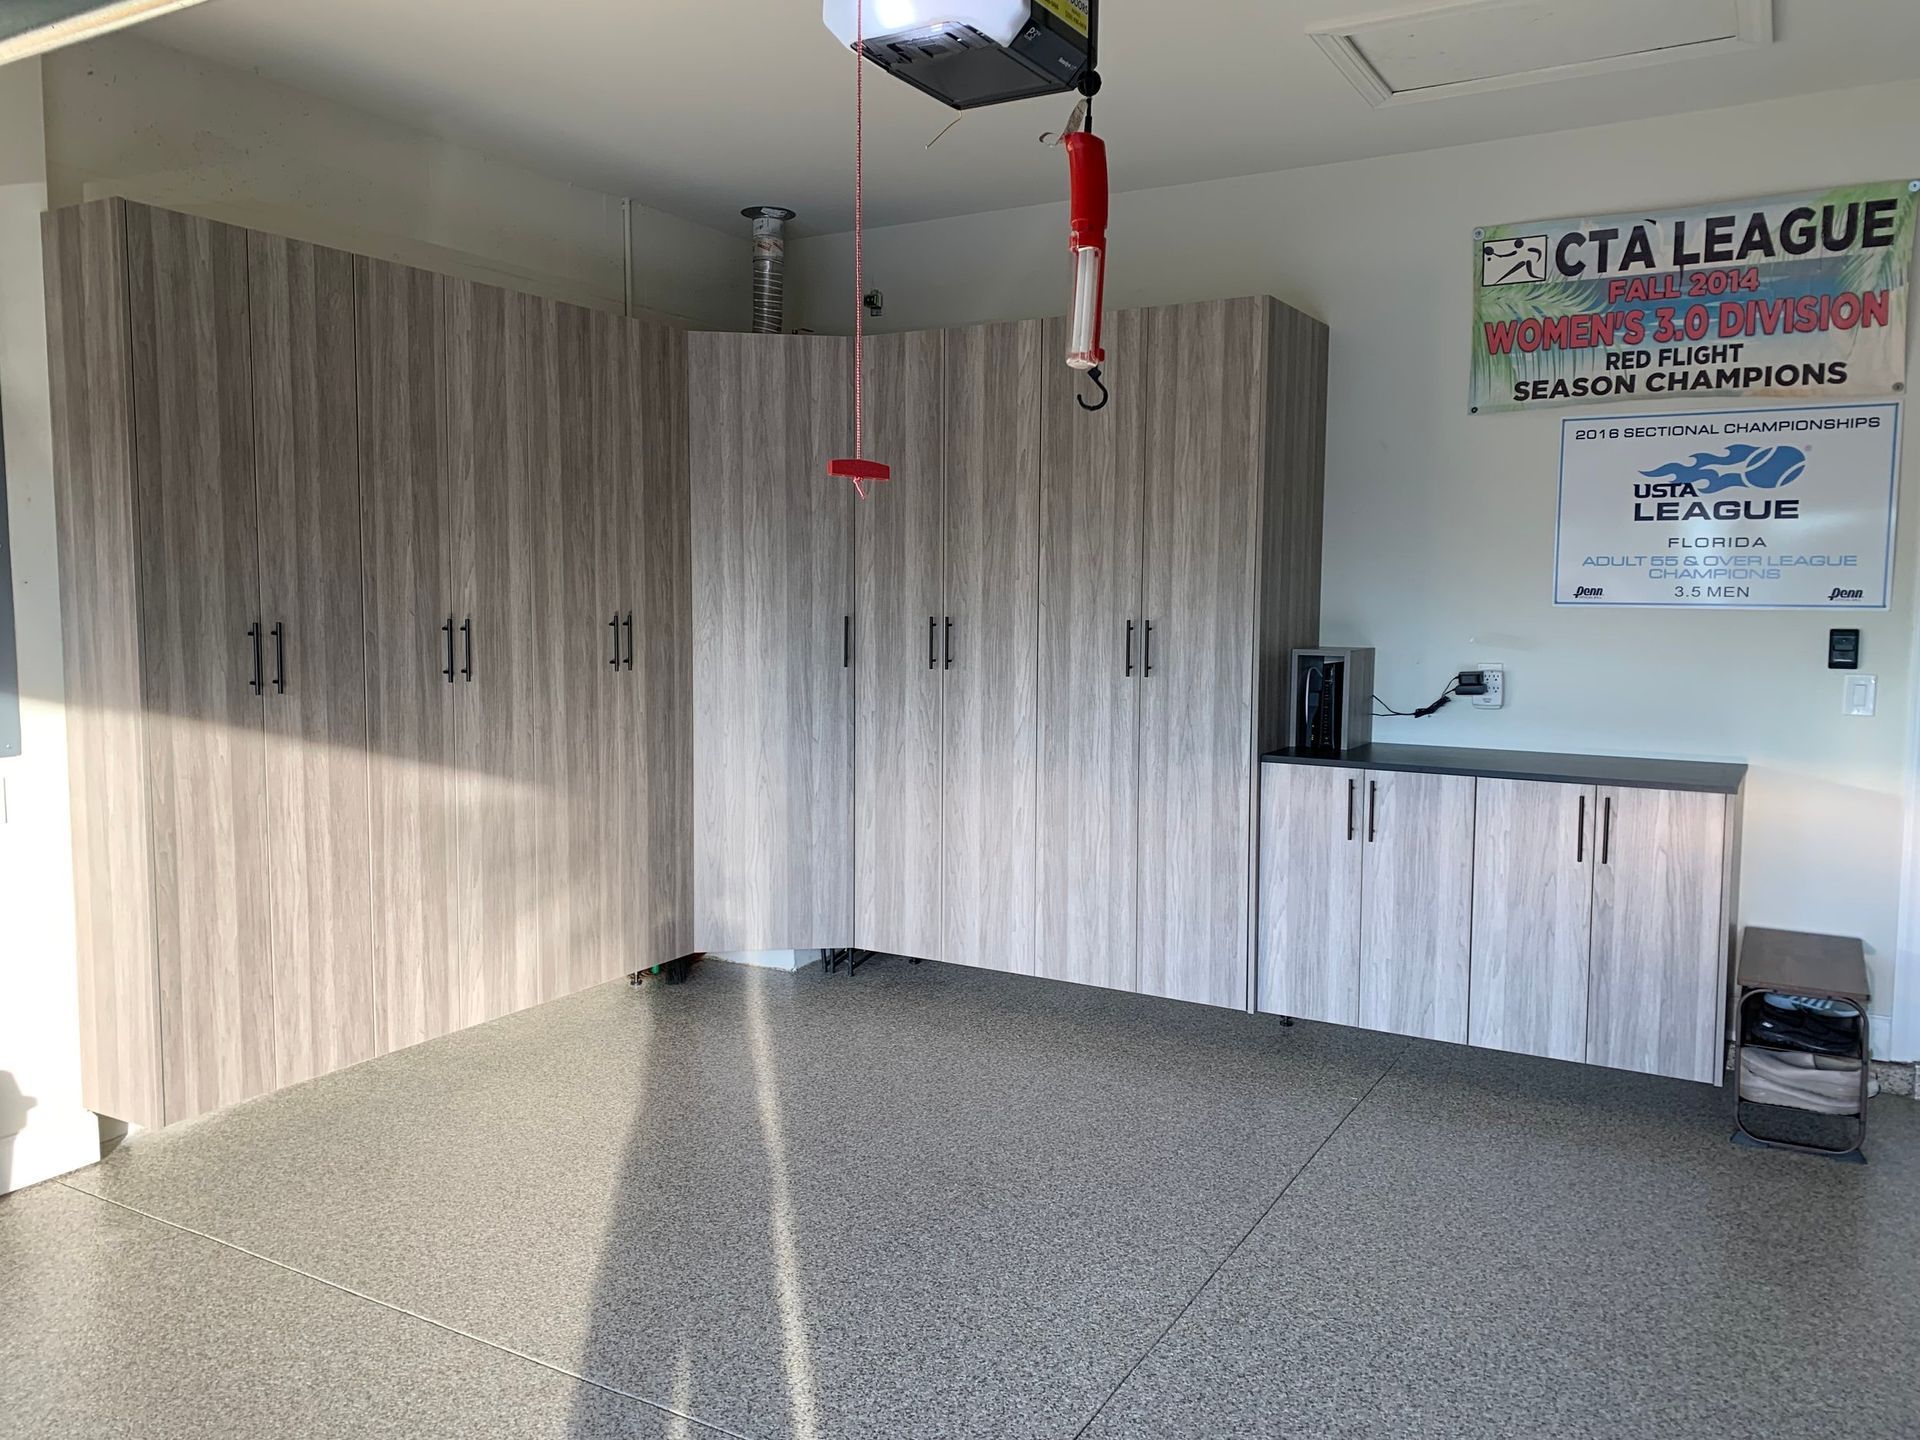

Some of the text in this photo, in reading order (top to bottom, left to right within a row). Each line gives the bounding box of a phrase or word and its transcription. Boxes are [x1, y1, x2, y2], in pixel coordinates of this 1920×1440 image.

[1555, 199, 1899, 277] CTA LEAGUE
[1608, 267, 1760, 304] FALL 2014
[1484, 290, 1890, 355] WOMEN'S 3.0 DIVISION
[1605, 343, 1745, 371] RED FLIGHT
[1513, 361, 1848, 401] SEASON CHAMPIONS
[1623, 423, 1720, 438] SECTIONAL
[1724, 416, 1881, 434] CHAMPIONSHIPS
[1633, 482, 1698, 499] USTA
[1634, 499, 1800, 522] LEAGUE
[1668, 536, 1767, 548] FLORIDA
[1582, 555, 1858, 567] ADULT 55 & OVER LEAGUE
[1648, 568, 1780, 580] CHAMPIONS
[1674, 586, 1750, 598] 3.5 MEN
